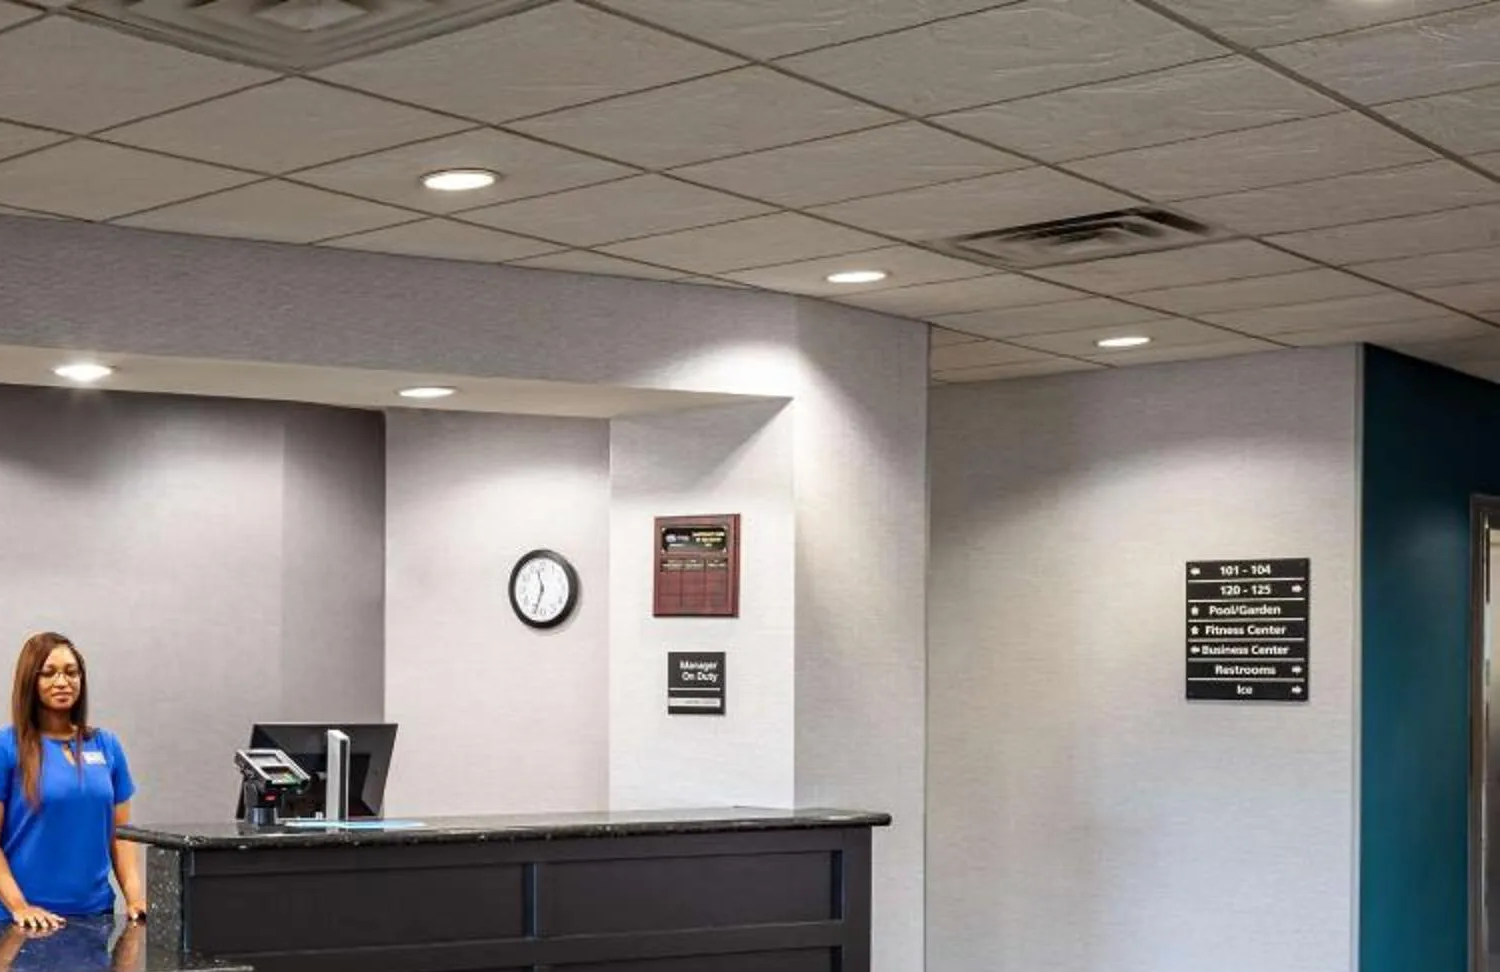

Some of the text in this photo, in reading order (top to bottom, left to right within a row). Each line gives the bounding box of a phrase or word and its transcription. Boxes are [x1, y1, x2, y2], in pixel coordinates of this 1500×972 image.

[1220, 566, 1239, 575] 101
[1251, 565, 1271, 574] 104
[1220, 586, 1240, 595] 120
[1251, 585, 1271, 594] 125
[1208, 604, 1282, 616] Pool/Garden
[1205, 625, 1287, 635] Fitness Center
[1201, 645, 1289, 655] Business Center
[679, 660, 718, 672] Manager
[1215, 664, 1277, 675] Restrooms
[681, 671, 718, 683] On Duty
[1236, 684, 1253, 695] Ice
